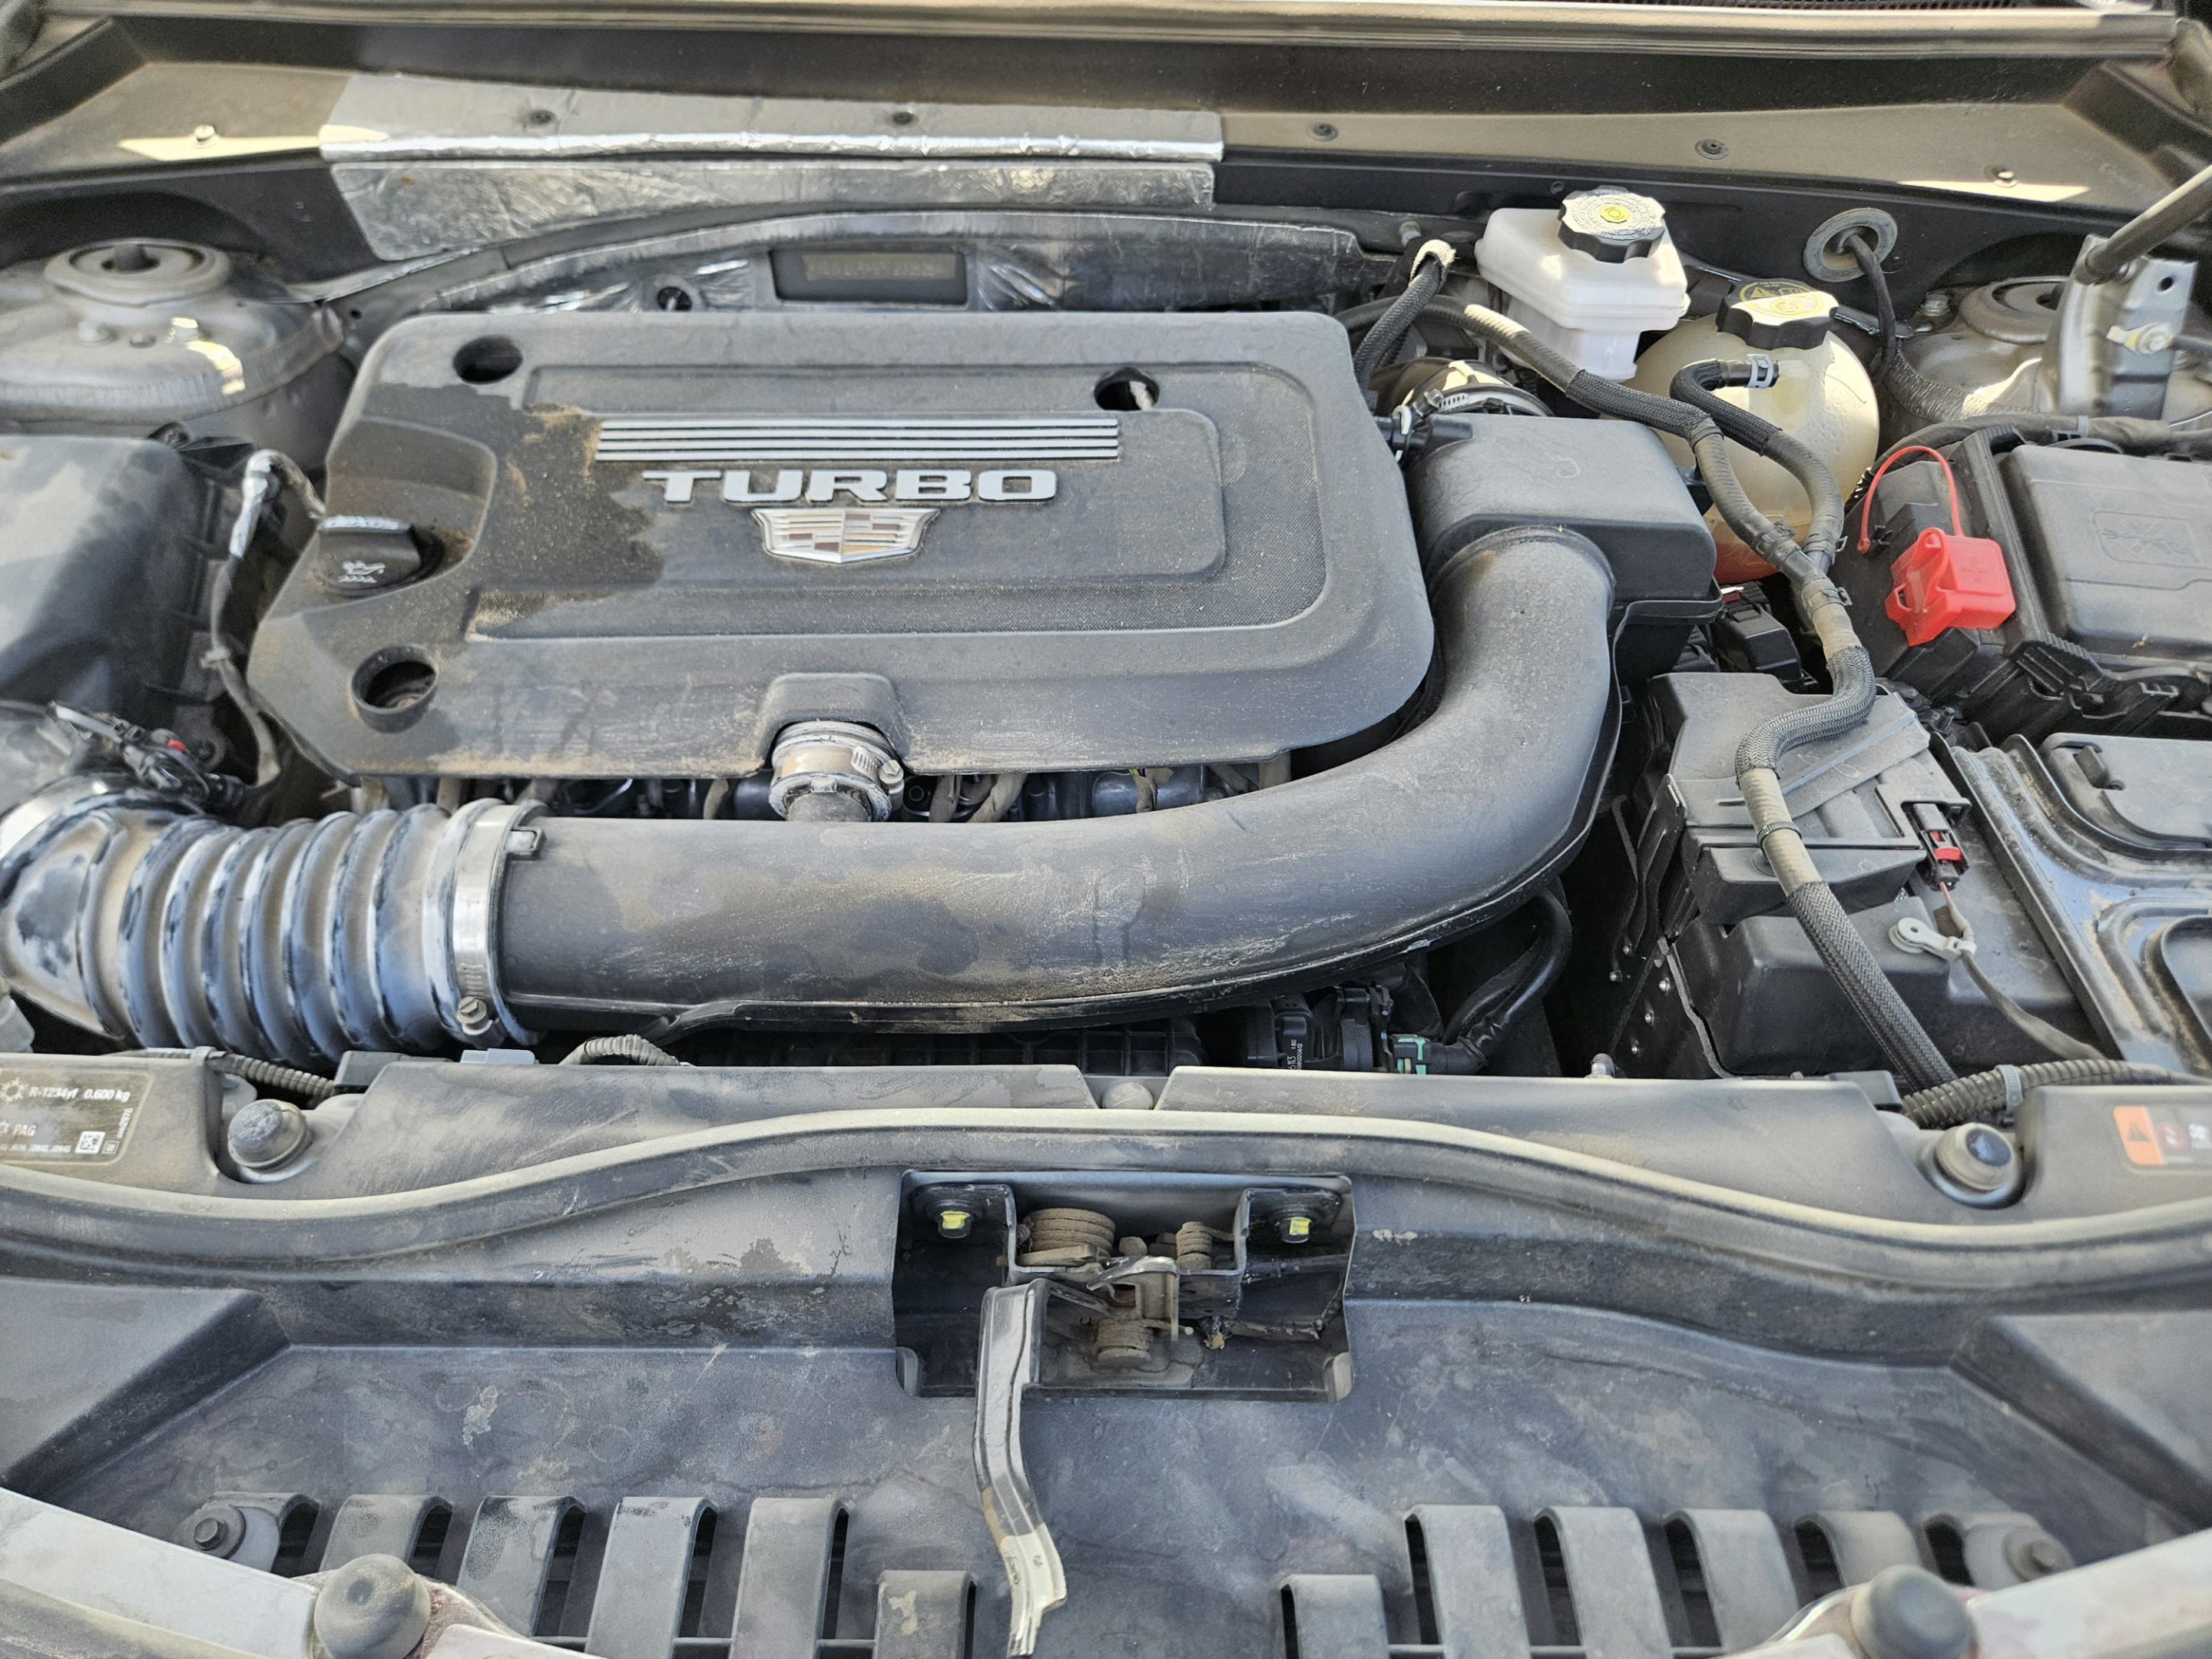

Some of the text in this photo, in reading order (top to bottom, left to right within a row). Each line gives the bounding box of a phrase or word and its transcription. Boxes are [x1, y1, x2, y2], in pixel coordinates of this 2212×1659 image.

[641, 469, 1057, 502] TURBO
[29, 1086, 131, 1103] R-1234yf 0.600 kg
[12, 1124, 37, 1137] PAG
